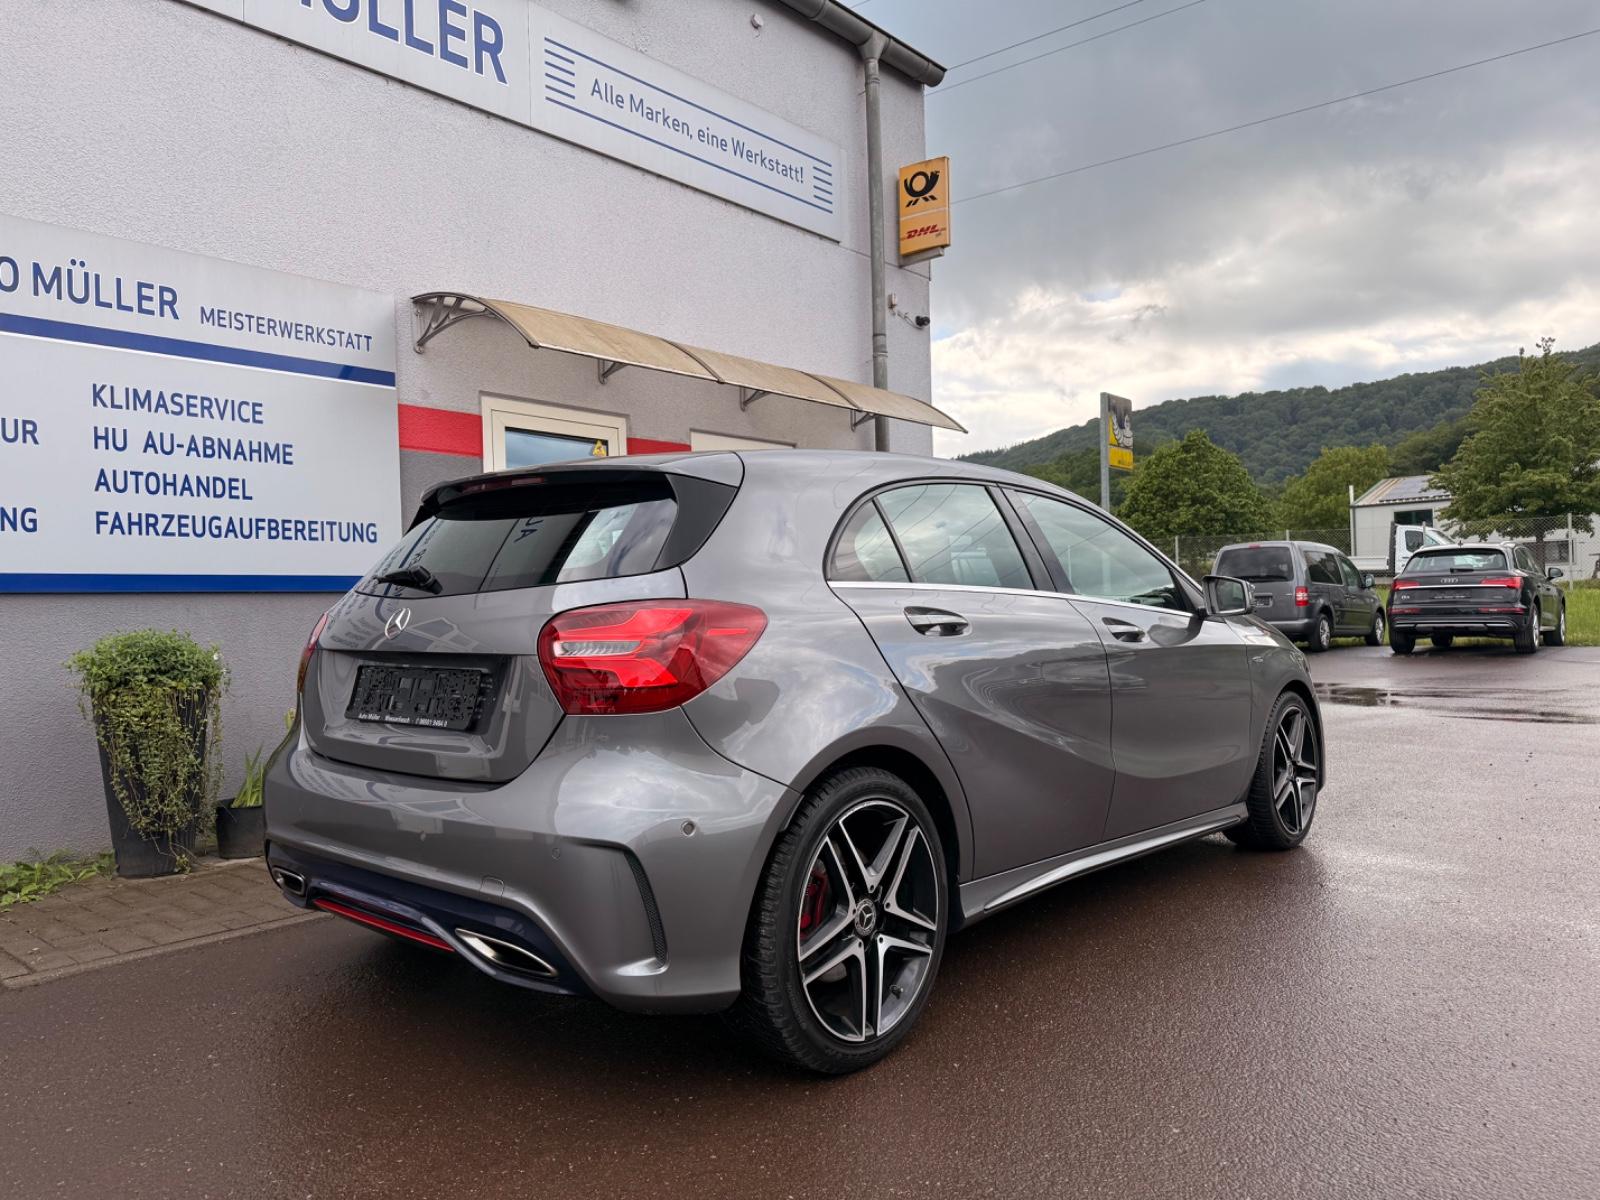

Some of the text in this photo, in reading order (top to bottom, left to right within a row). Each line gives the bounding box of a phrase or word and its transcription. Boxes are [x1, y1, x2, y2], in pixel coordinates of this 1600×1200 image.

[300, 0, 508, 85] LLER
[591, 78, 804, 183] Alle Marken, eine Werkstatt!
[906, 224, 939, 239] DHL
[32, 258, 179, 320] MÜLLER
[200, 306, 372, 352] MEISTERWERKSTATT
[92, 383, 264, 424] KLIMASERVICE
[0, 417, 39, 445] UR
[93, 426, 294, 465] HU AU-ABNAHME
[94, 468, 253, 500] AUTOHANDEL
[0, 506, 38, 533] NG
[95, 511, 378, 543] FAHRZEUGAUFBEREITUNG
